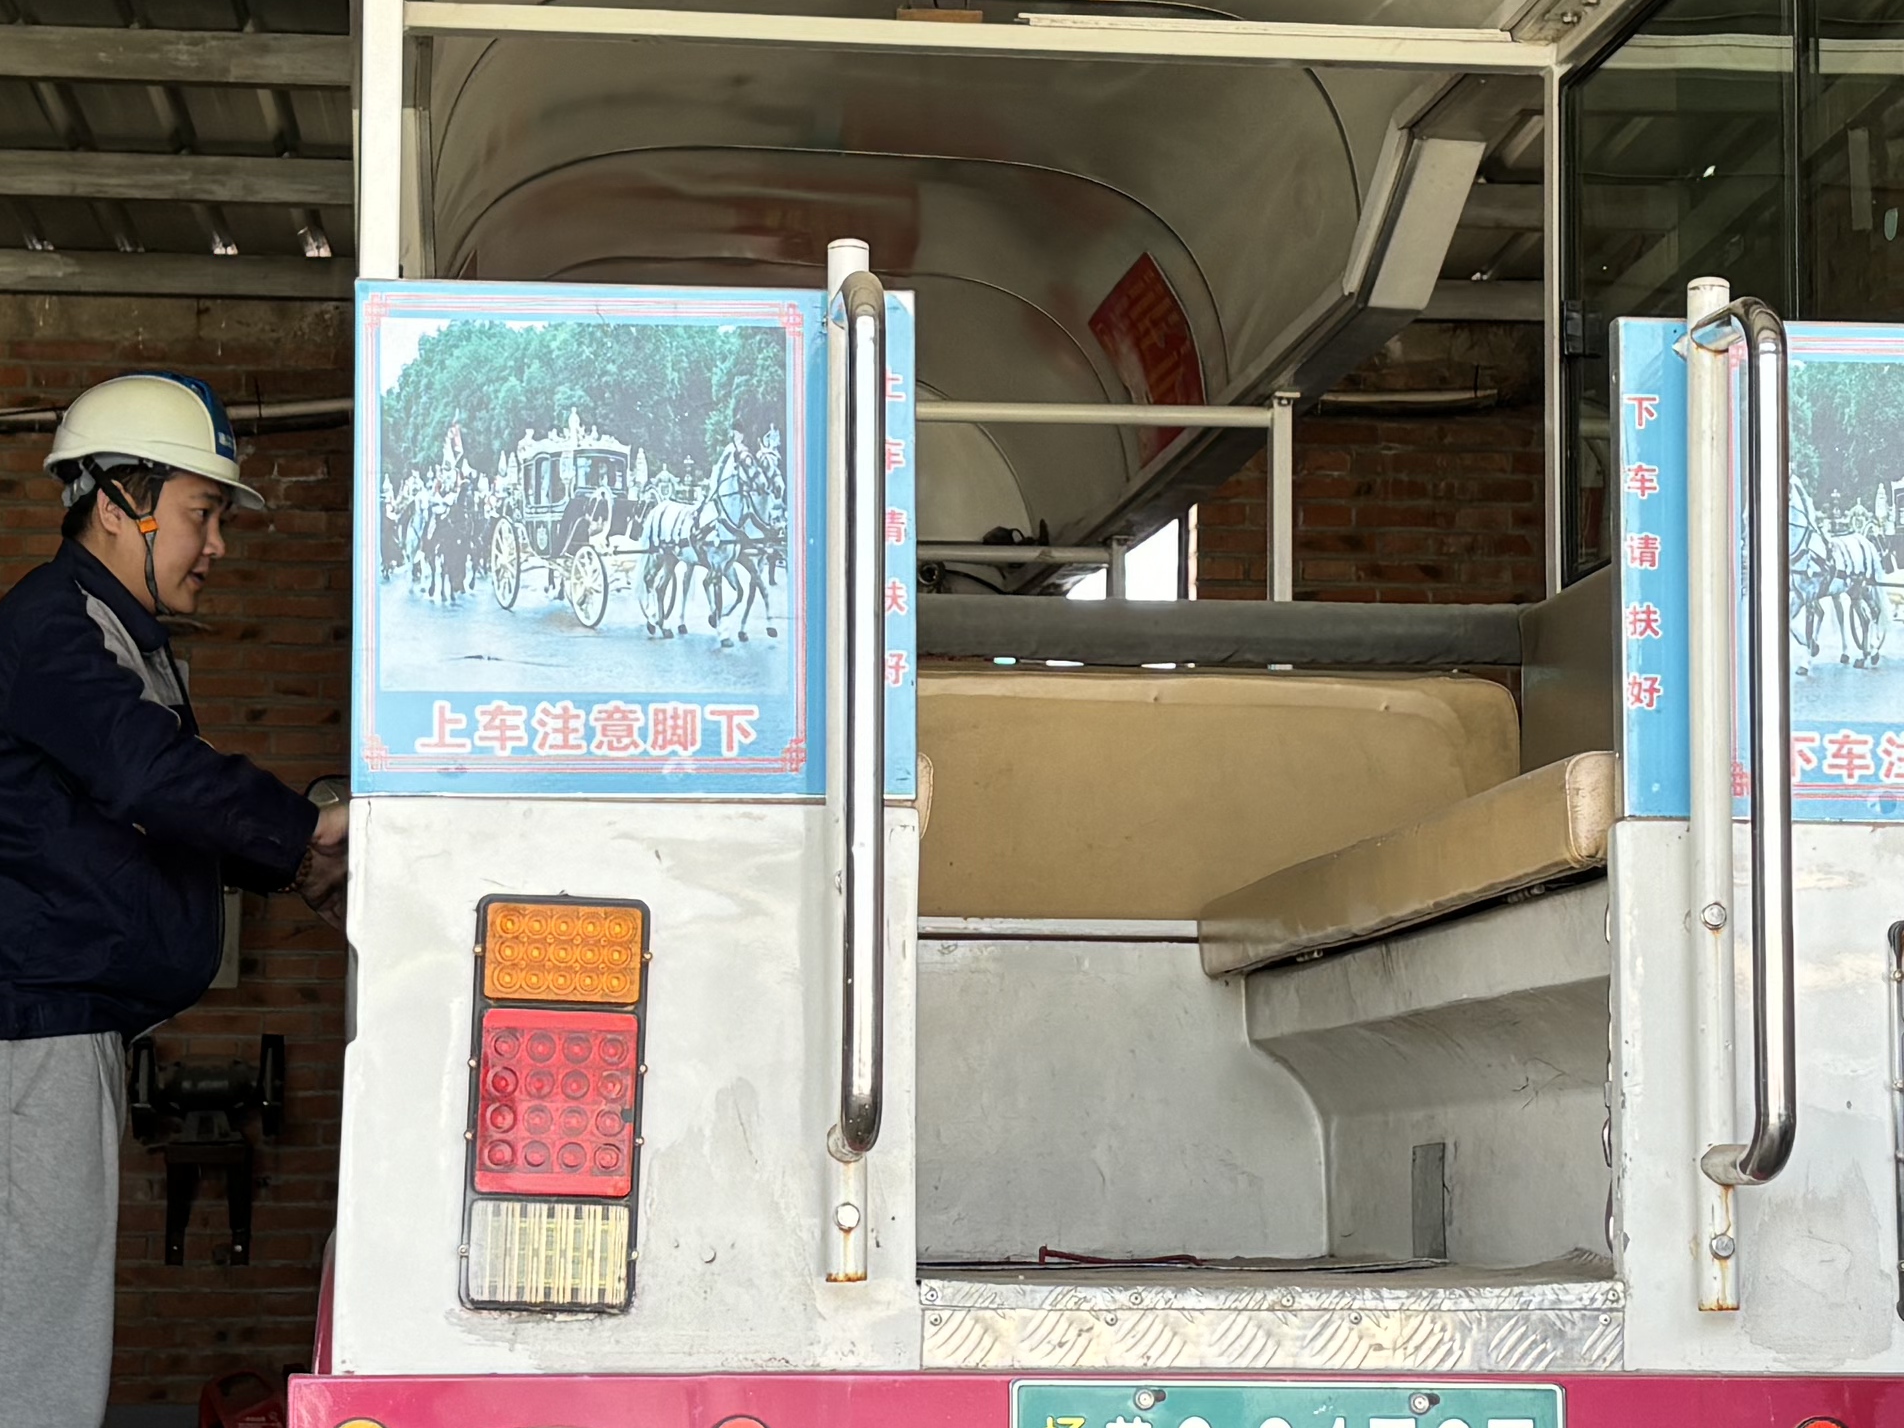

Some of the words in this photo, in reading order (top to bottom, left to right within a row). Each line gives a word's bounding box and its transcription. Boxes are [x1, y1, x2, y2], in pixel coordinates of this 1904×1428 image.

[1625, 395, 1662, 709] 下车请扶好
[418, 702, 758, 756] 上车注意脚下
